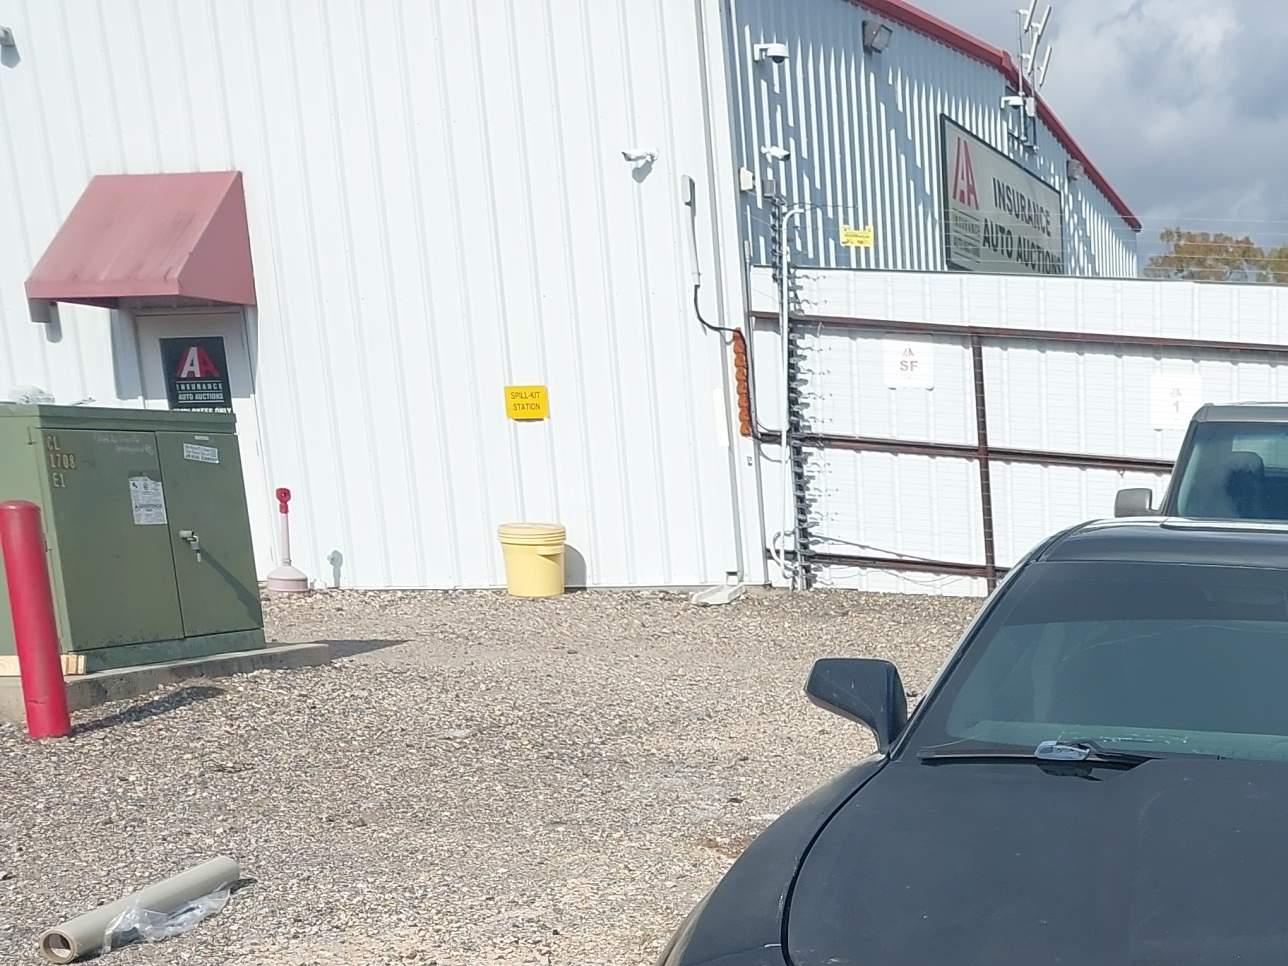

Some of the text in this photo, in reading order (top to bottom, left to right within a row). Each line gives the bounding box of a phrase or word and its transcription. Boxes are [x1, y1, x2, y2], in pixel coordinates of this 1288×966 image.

[992, 177, 1051, 237] INSURANCE
[982, 217, 1013, 259] AUTO
[899, 360, 919, 372] SF
[513, 402, 540, 411] STATION
